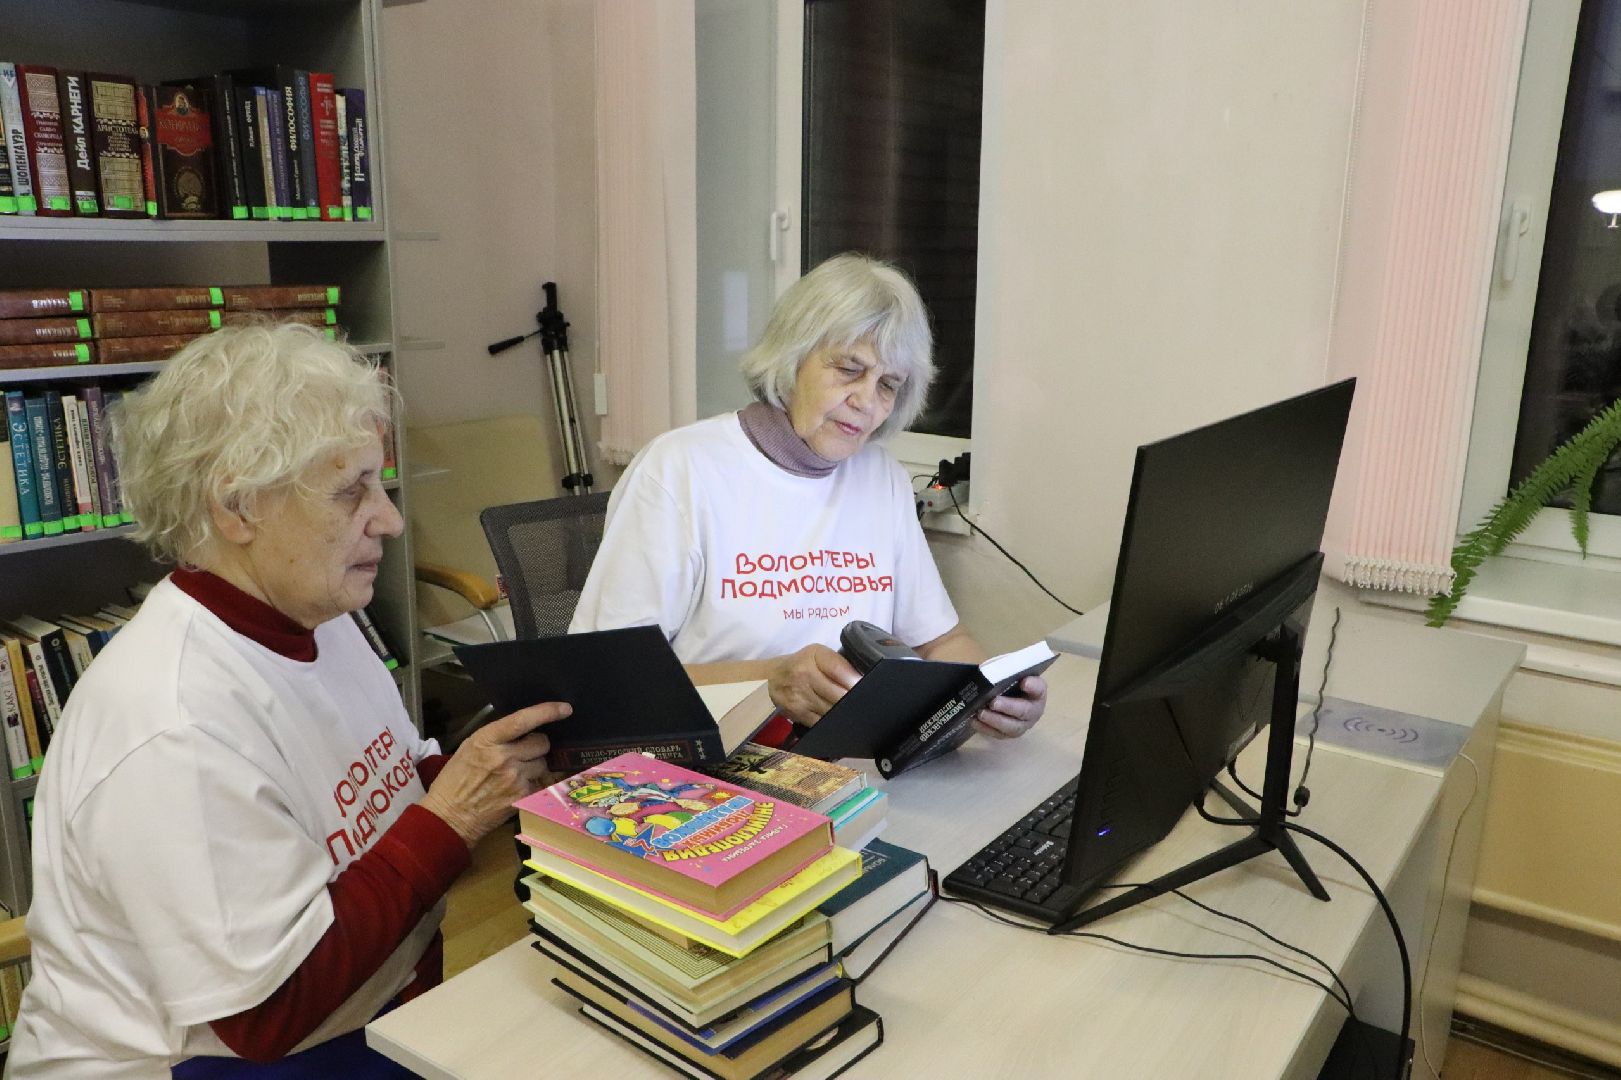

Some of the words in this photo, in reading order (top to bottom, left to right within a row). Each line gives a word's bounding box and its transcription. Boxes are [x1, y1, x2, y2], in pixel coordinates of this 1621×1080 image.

[67, 76, 85, 135] КАРНЕГИ
[285, 86, 297, 151] ФИЛОСОФИЯ
[298, 76, 310, 140] ФИЛОСОФИЯ
[12, 129, 29, 185] ШОПЕНГАУЭР
[75, 137, 90, 170] Дейл
[736, 550, 875, 574] ВОЛОНТЕРЫ
[721, 575, 893, 599] ПОДМОСКОВЬЯ
[784, 608, 804, 620] МЫ
[808, 605, 850, 619] РЯДОМ
[919, 698, 957, 733] АНГЛИЙСКИЙ
[920, 700, 966, 741] АМЕРИКАНСКИЙ
[645, 744, 681, 754] СЛОВАРЬ
[662, 802, 775, 862] ЭНЦИКЛОПЕДИЯ
[682, 809, 752, 848] ЛЮБИМЫХ
